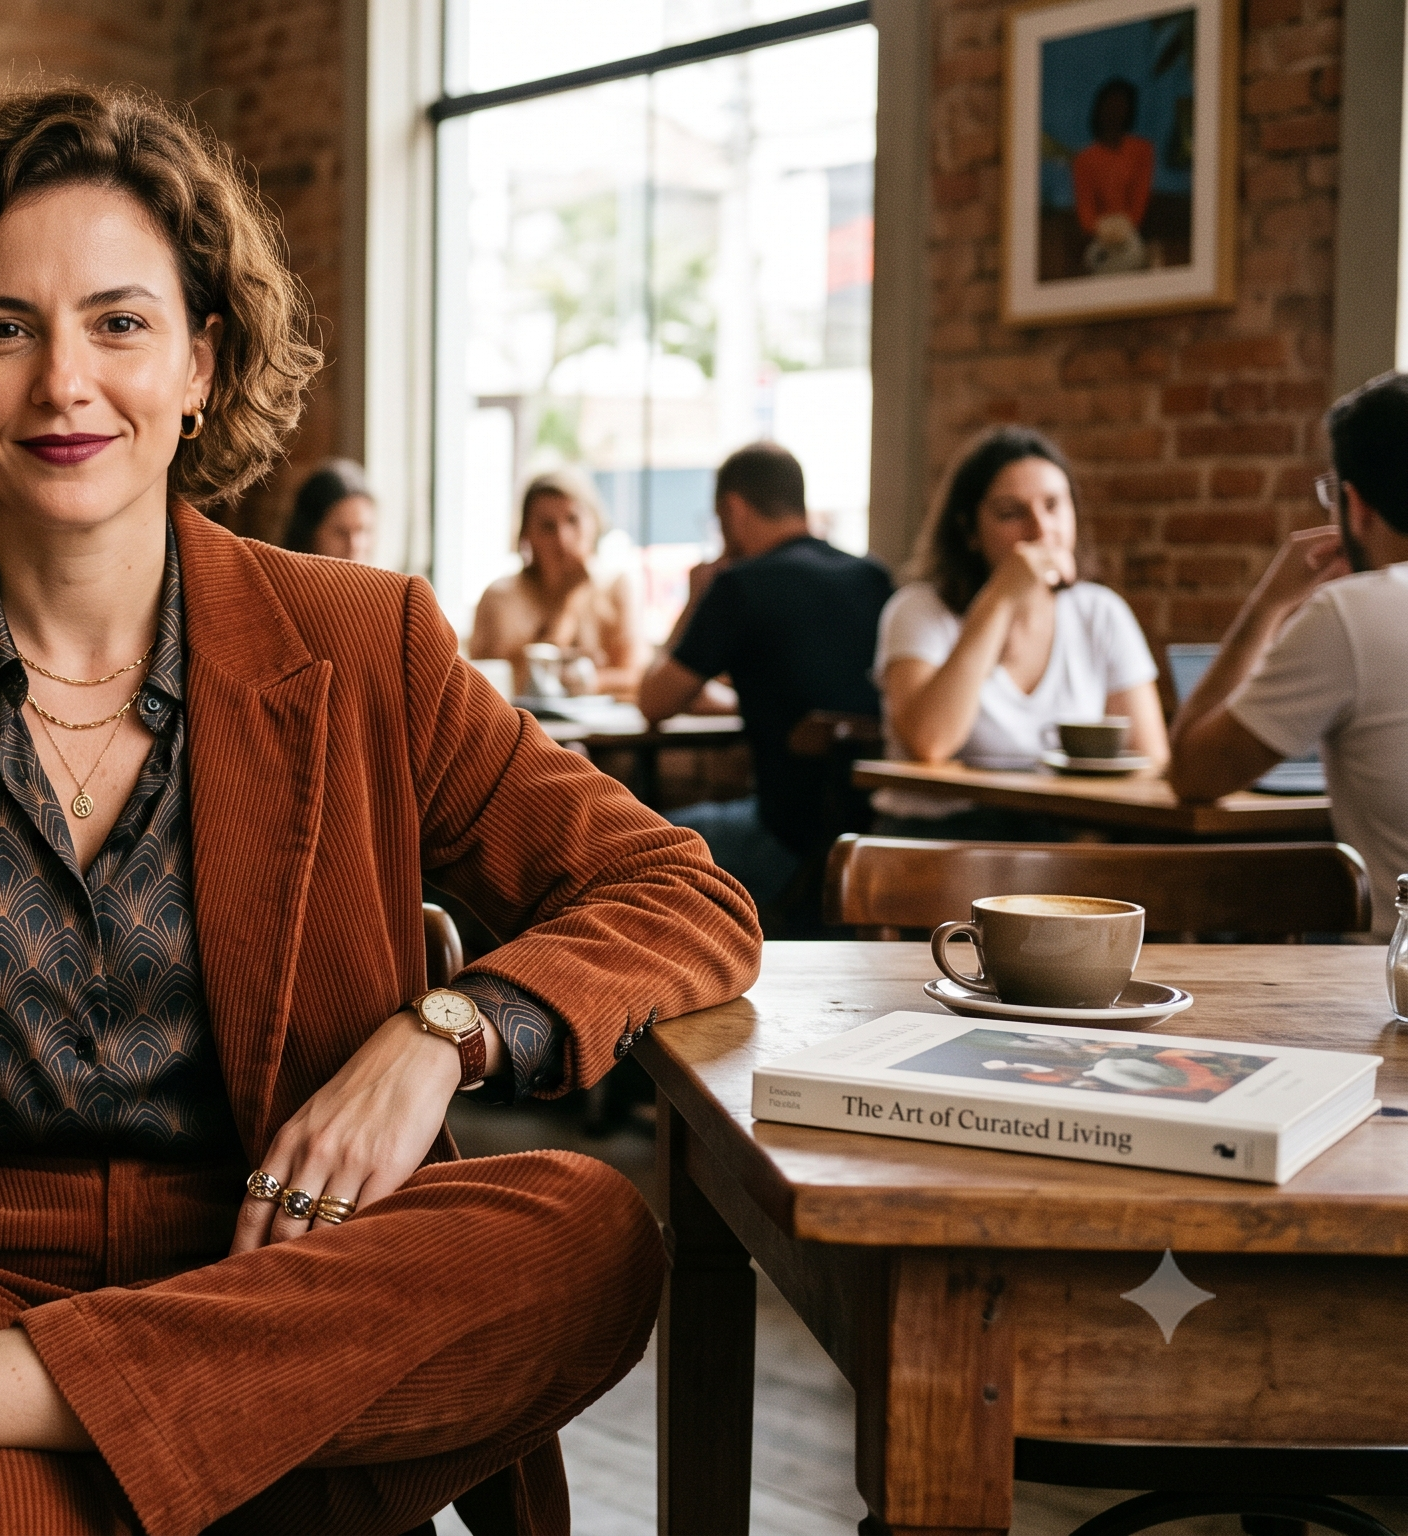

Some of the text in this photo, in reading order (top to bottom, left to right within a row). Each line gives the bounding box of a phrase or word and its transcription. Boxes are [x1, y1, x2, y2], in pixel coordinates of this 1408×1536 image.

[842, 1095, 1132, 1154] The Art of Curated Living
